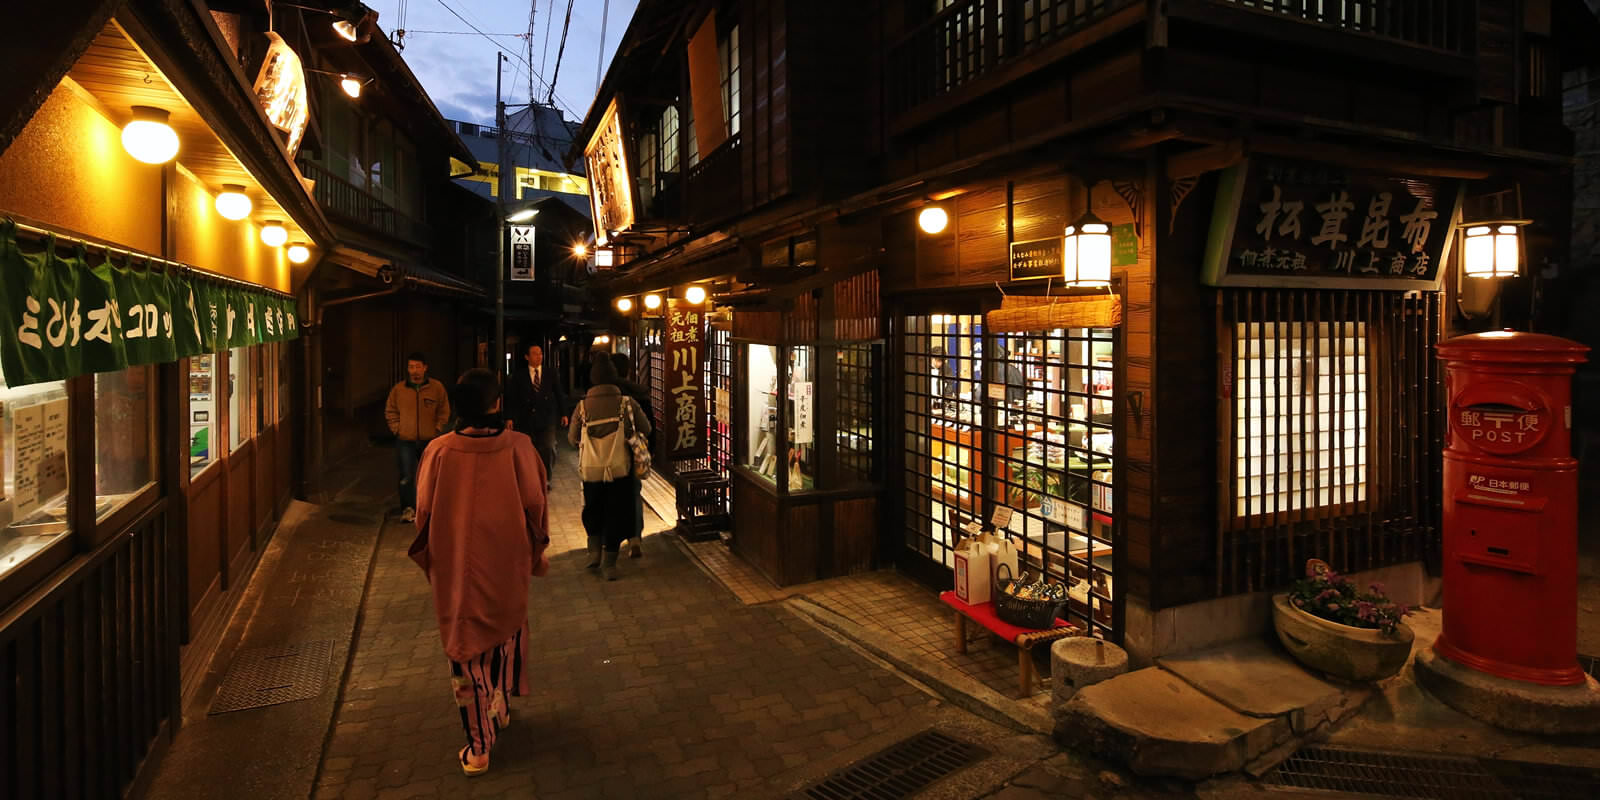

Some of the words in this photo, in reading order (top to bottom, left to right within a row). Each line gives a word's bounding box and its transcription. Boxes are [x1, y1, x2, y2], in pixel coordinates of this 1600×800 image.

[1255, 184, 1439, 254] 松茸昆布
[1335, 249, 1431, 276] 川上商店
[671, 346, 699, 451] 川上商店
[1472, 429, 1526, 443] POST
